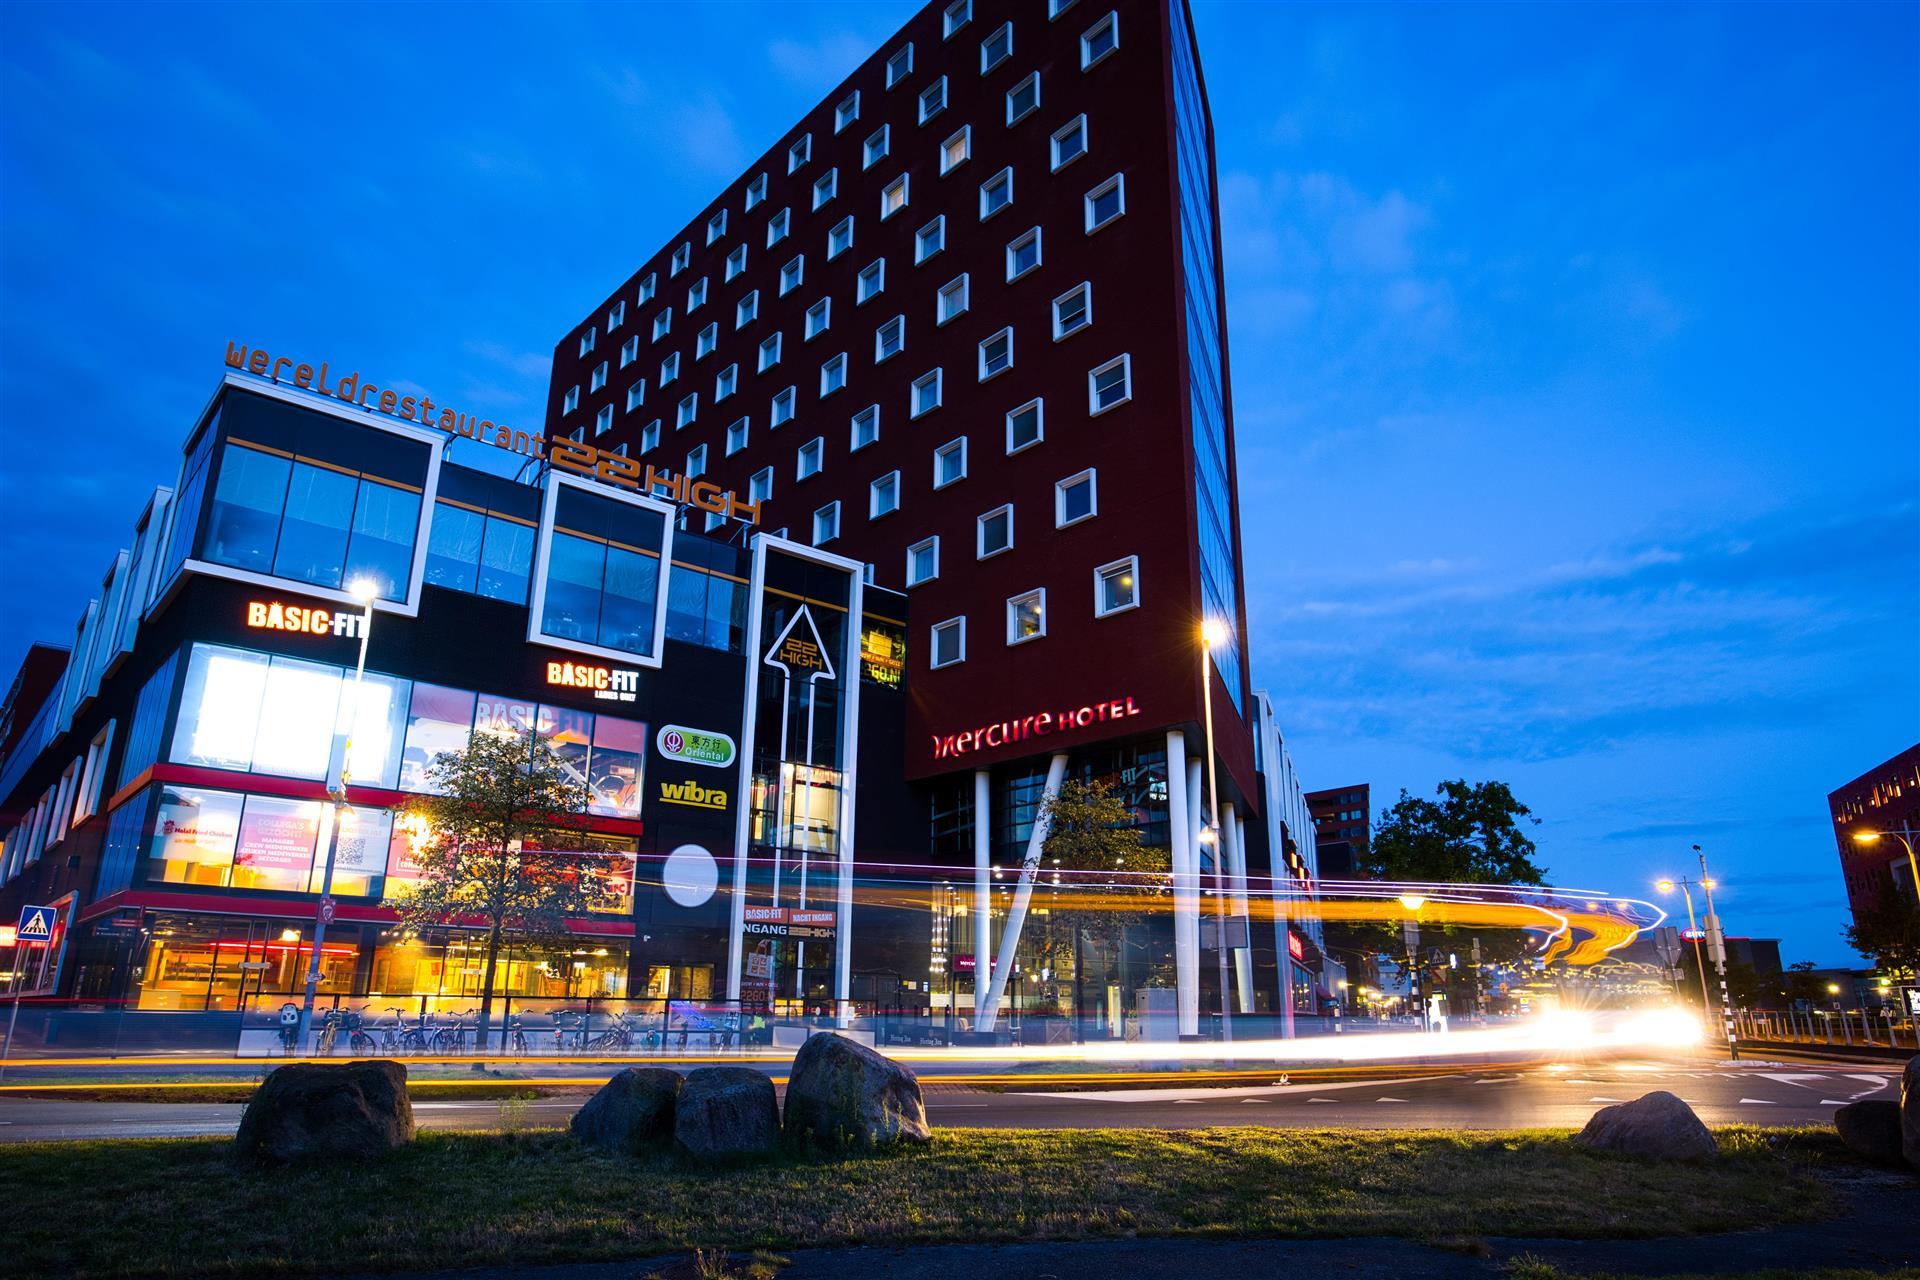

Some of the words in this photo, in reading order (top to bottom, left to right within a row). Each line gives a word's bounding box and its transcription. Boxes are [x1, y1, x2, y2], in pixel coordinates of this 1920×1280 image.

[226, 340, 547, 459] wereldrestaurant
[645, 464, 761, 526] HIGH
[247, 601, 368, 639] BASIC-FIT
[786, 638, 817, 656] 22
[780, 649, 822, 670] HIGH
[547, 661, 639, 692] BASIC-FIT
[1058, 696, 1140, 731] HOTEL
[685, 747, 724, 761] Oriental
[661, 781, 727, 806] wibra
[745, 908, 782, 919] BASIC-FIT
[793, 914, 811, 922] NACHT
[812, 913, 833, 922] INGANG
[743, 923, 787, 935] NGANG
